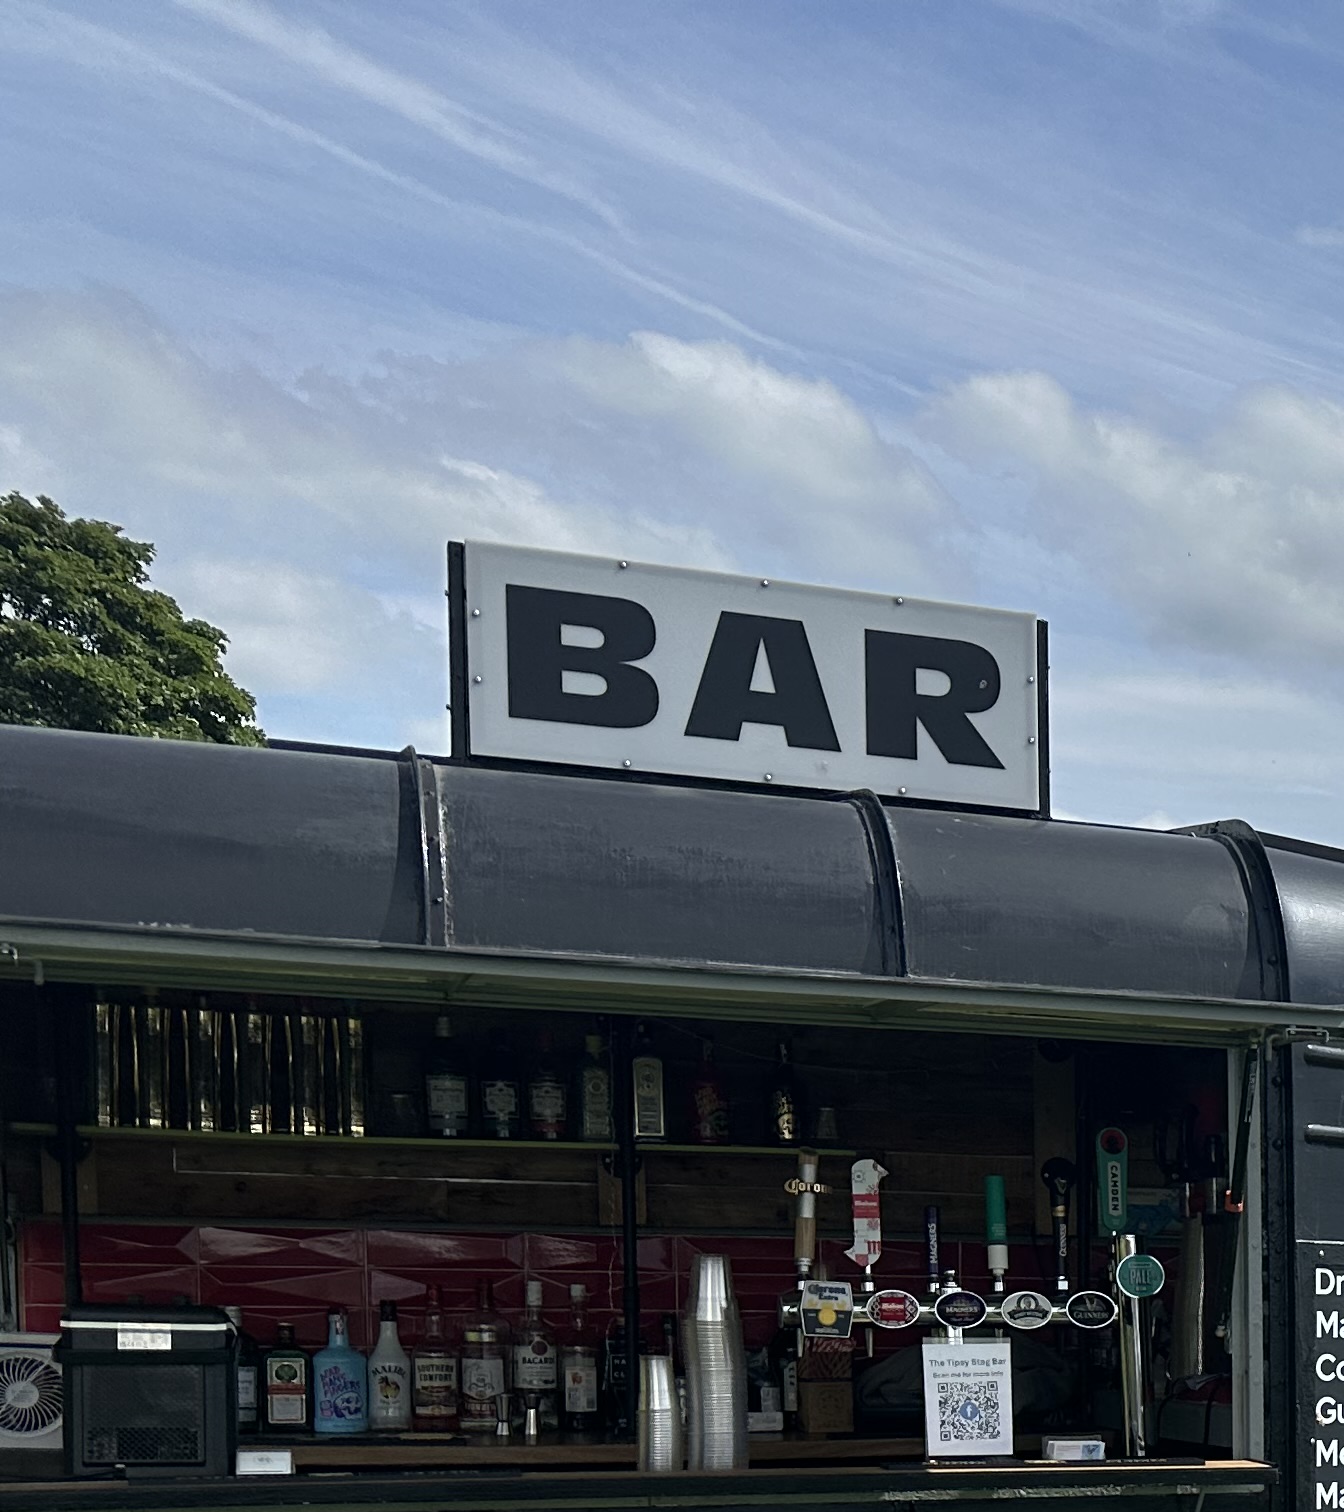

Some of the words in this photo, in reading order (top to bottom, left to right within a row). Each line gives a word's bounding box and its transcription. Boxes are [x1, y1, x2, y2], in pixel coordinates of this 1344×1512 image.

[506, 584, 1006, 770] BAR
[1110, 1165, 1120, 1211] CAMDEN
[1073, 1311, 1109, 1320] GUINNESS
[929, 1359, 945, 1367] The
[946, 1359, 970, 1368] Tipsy
[992, 1357, 1006, 1366] Bar
[417, 1364, 454, 1372] SOUTHERN
[419, 1373, 452, 1382] COMFORT
